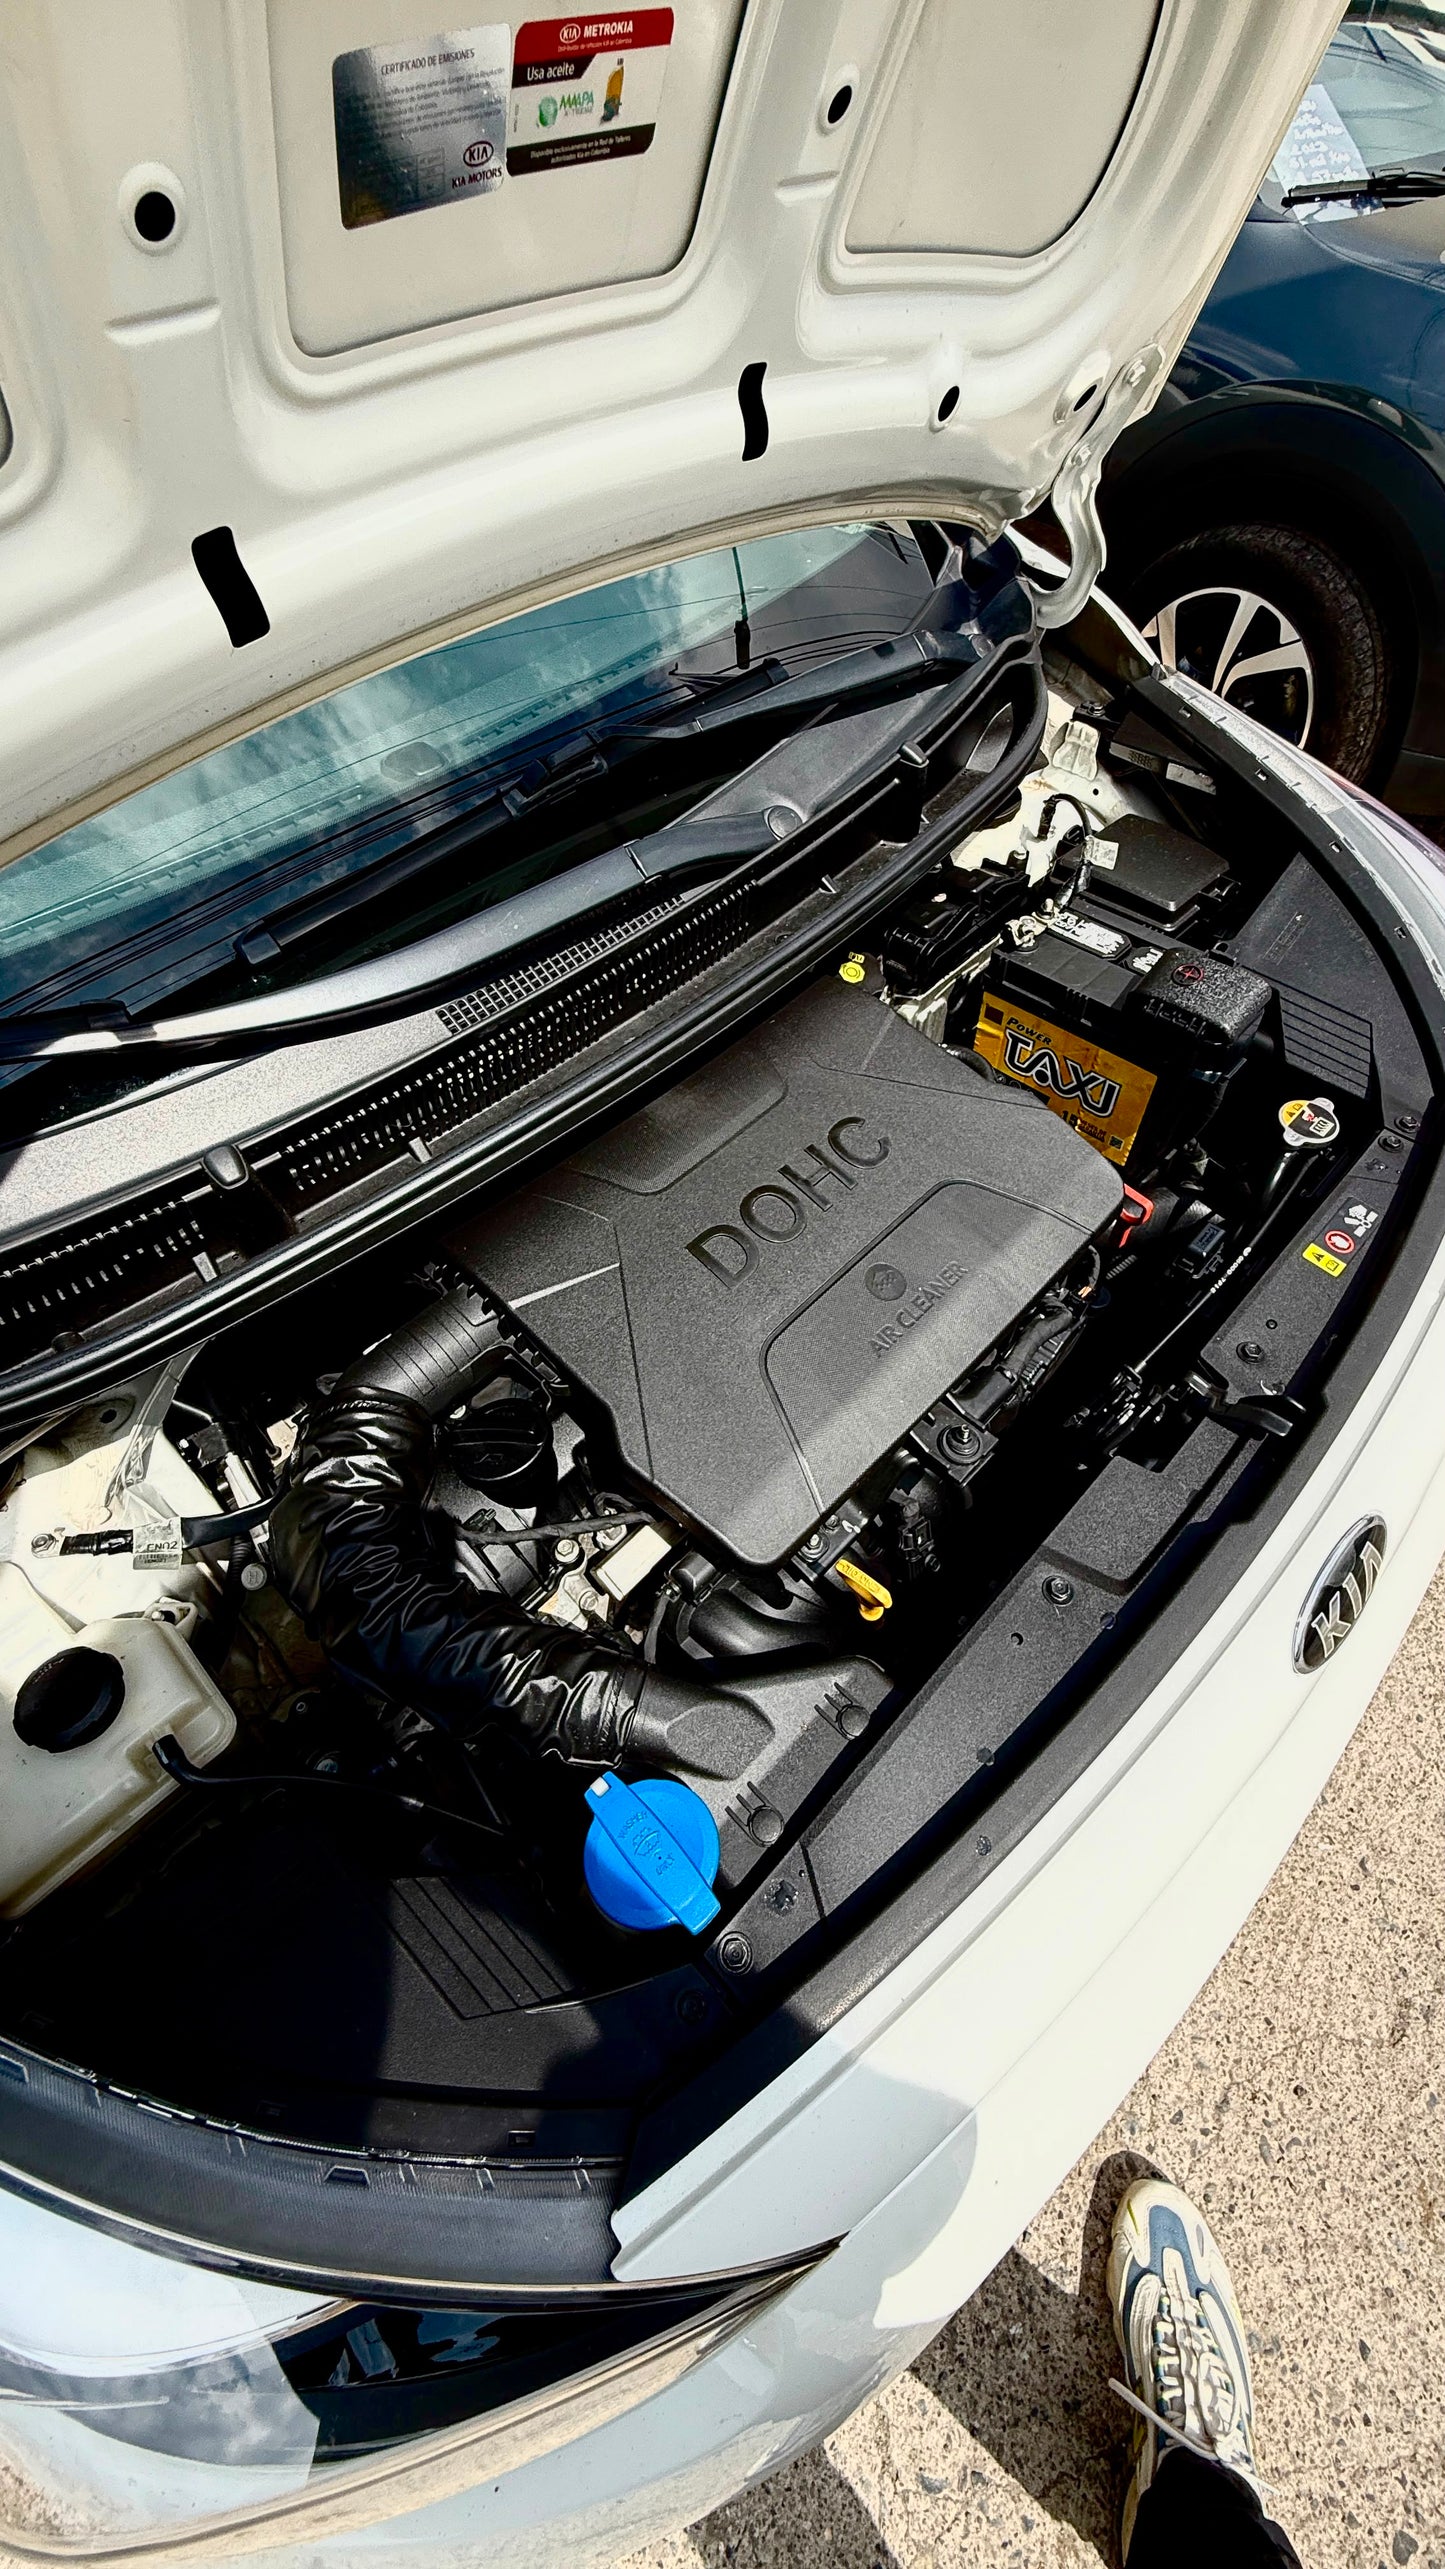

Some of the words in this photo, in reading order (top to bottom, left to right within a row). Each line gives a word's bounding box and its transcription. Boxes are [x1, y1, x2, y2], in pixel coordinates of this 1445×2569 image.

[583, 20, 633, 38] METROKIA
[381, 57, 427, 76] CERTIFICADO
[427, 55, 437, 67] DE
[438, 48, 475, 64] EMISIONES
[527, 66, 544, 81] Usa
[547, 62, 575, 78] aceite
[451, 177, 466, 190] KIA
[468, 166, 502, 184] MOTORS
[1004, 1028, 1122, 1118] TAXI
[684, 1116, 891, 1290] DOHC
[869, 1324, 904, 1359] AIR
[895, 1260, 969, 1330] CLEANER
[1311, 1541, 1383, 1659] KIA
